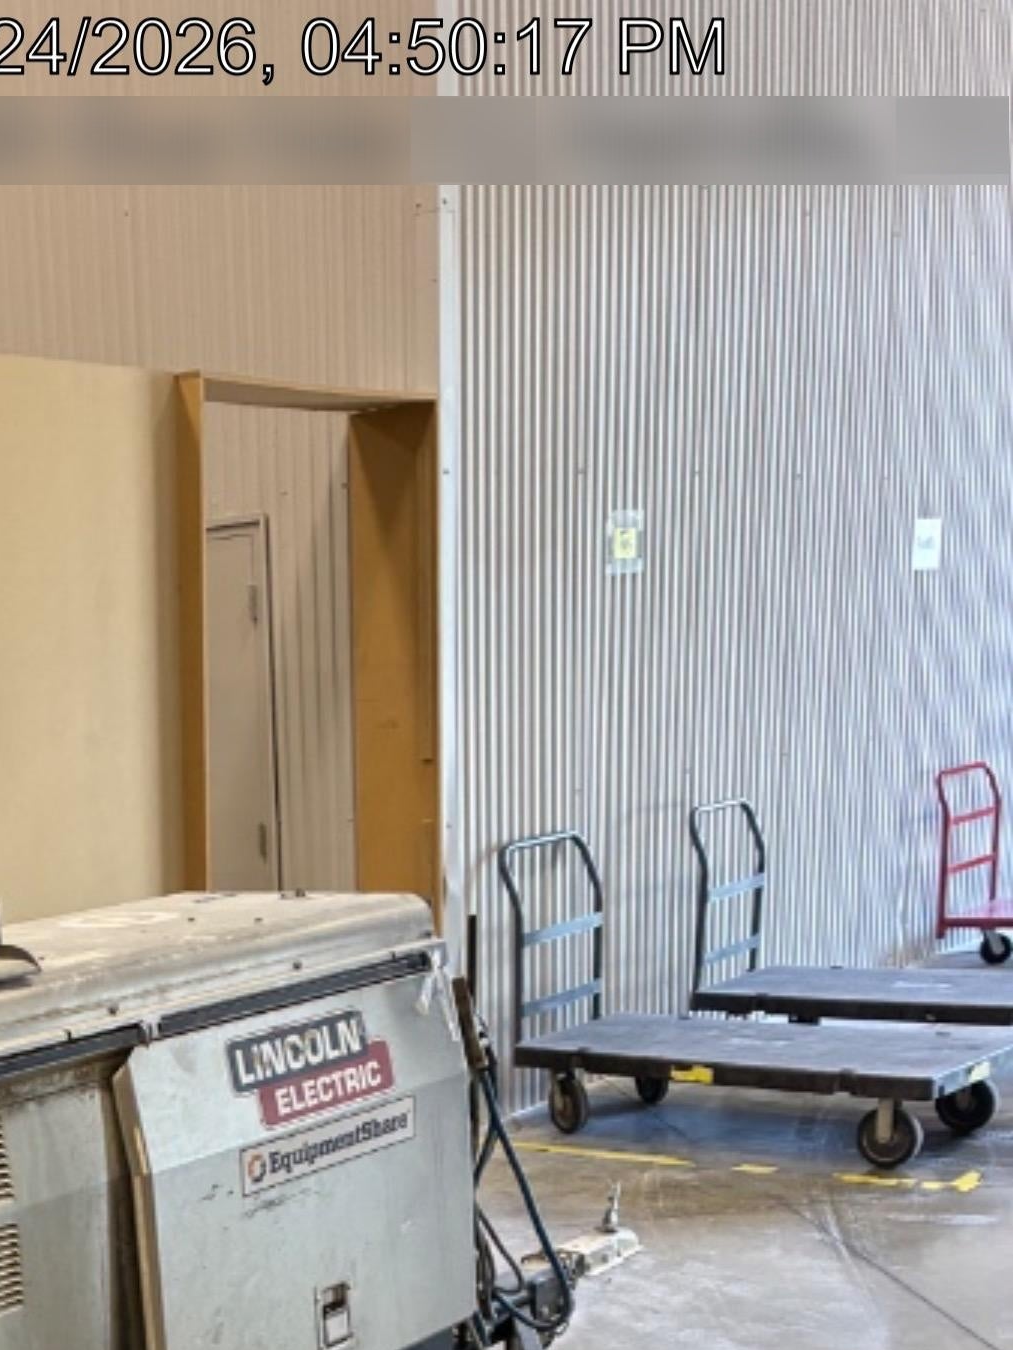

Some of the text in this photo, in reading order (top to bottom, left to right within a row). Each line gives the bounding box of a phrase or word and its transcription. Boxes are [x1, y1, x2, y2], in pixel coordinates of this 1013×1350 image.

[235, 1017, 362, 1085] LINCOLN
[274, 1060, 382, 1117] ELECTRIC
[268, 1113, 409, 1174] EquipmentShare
